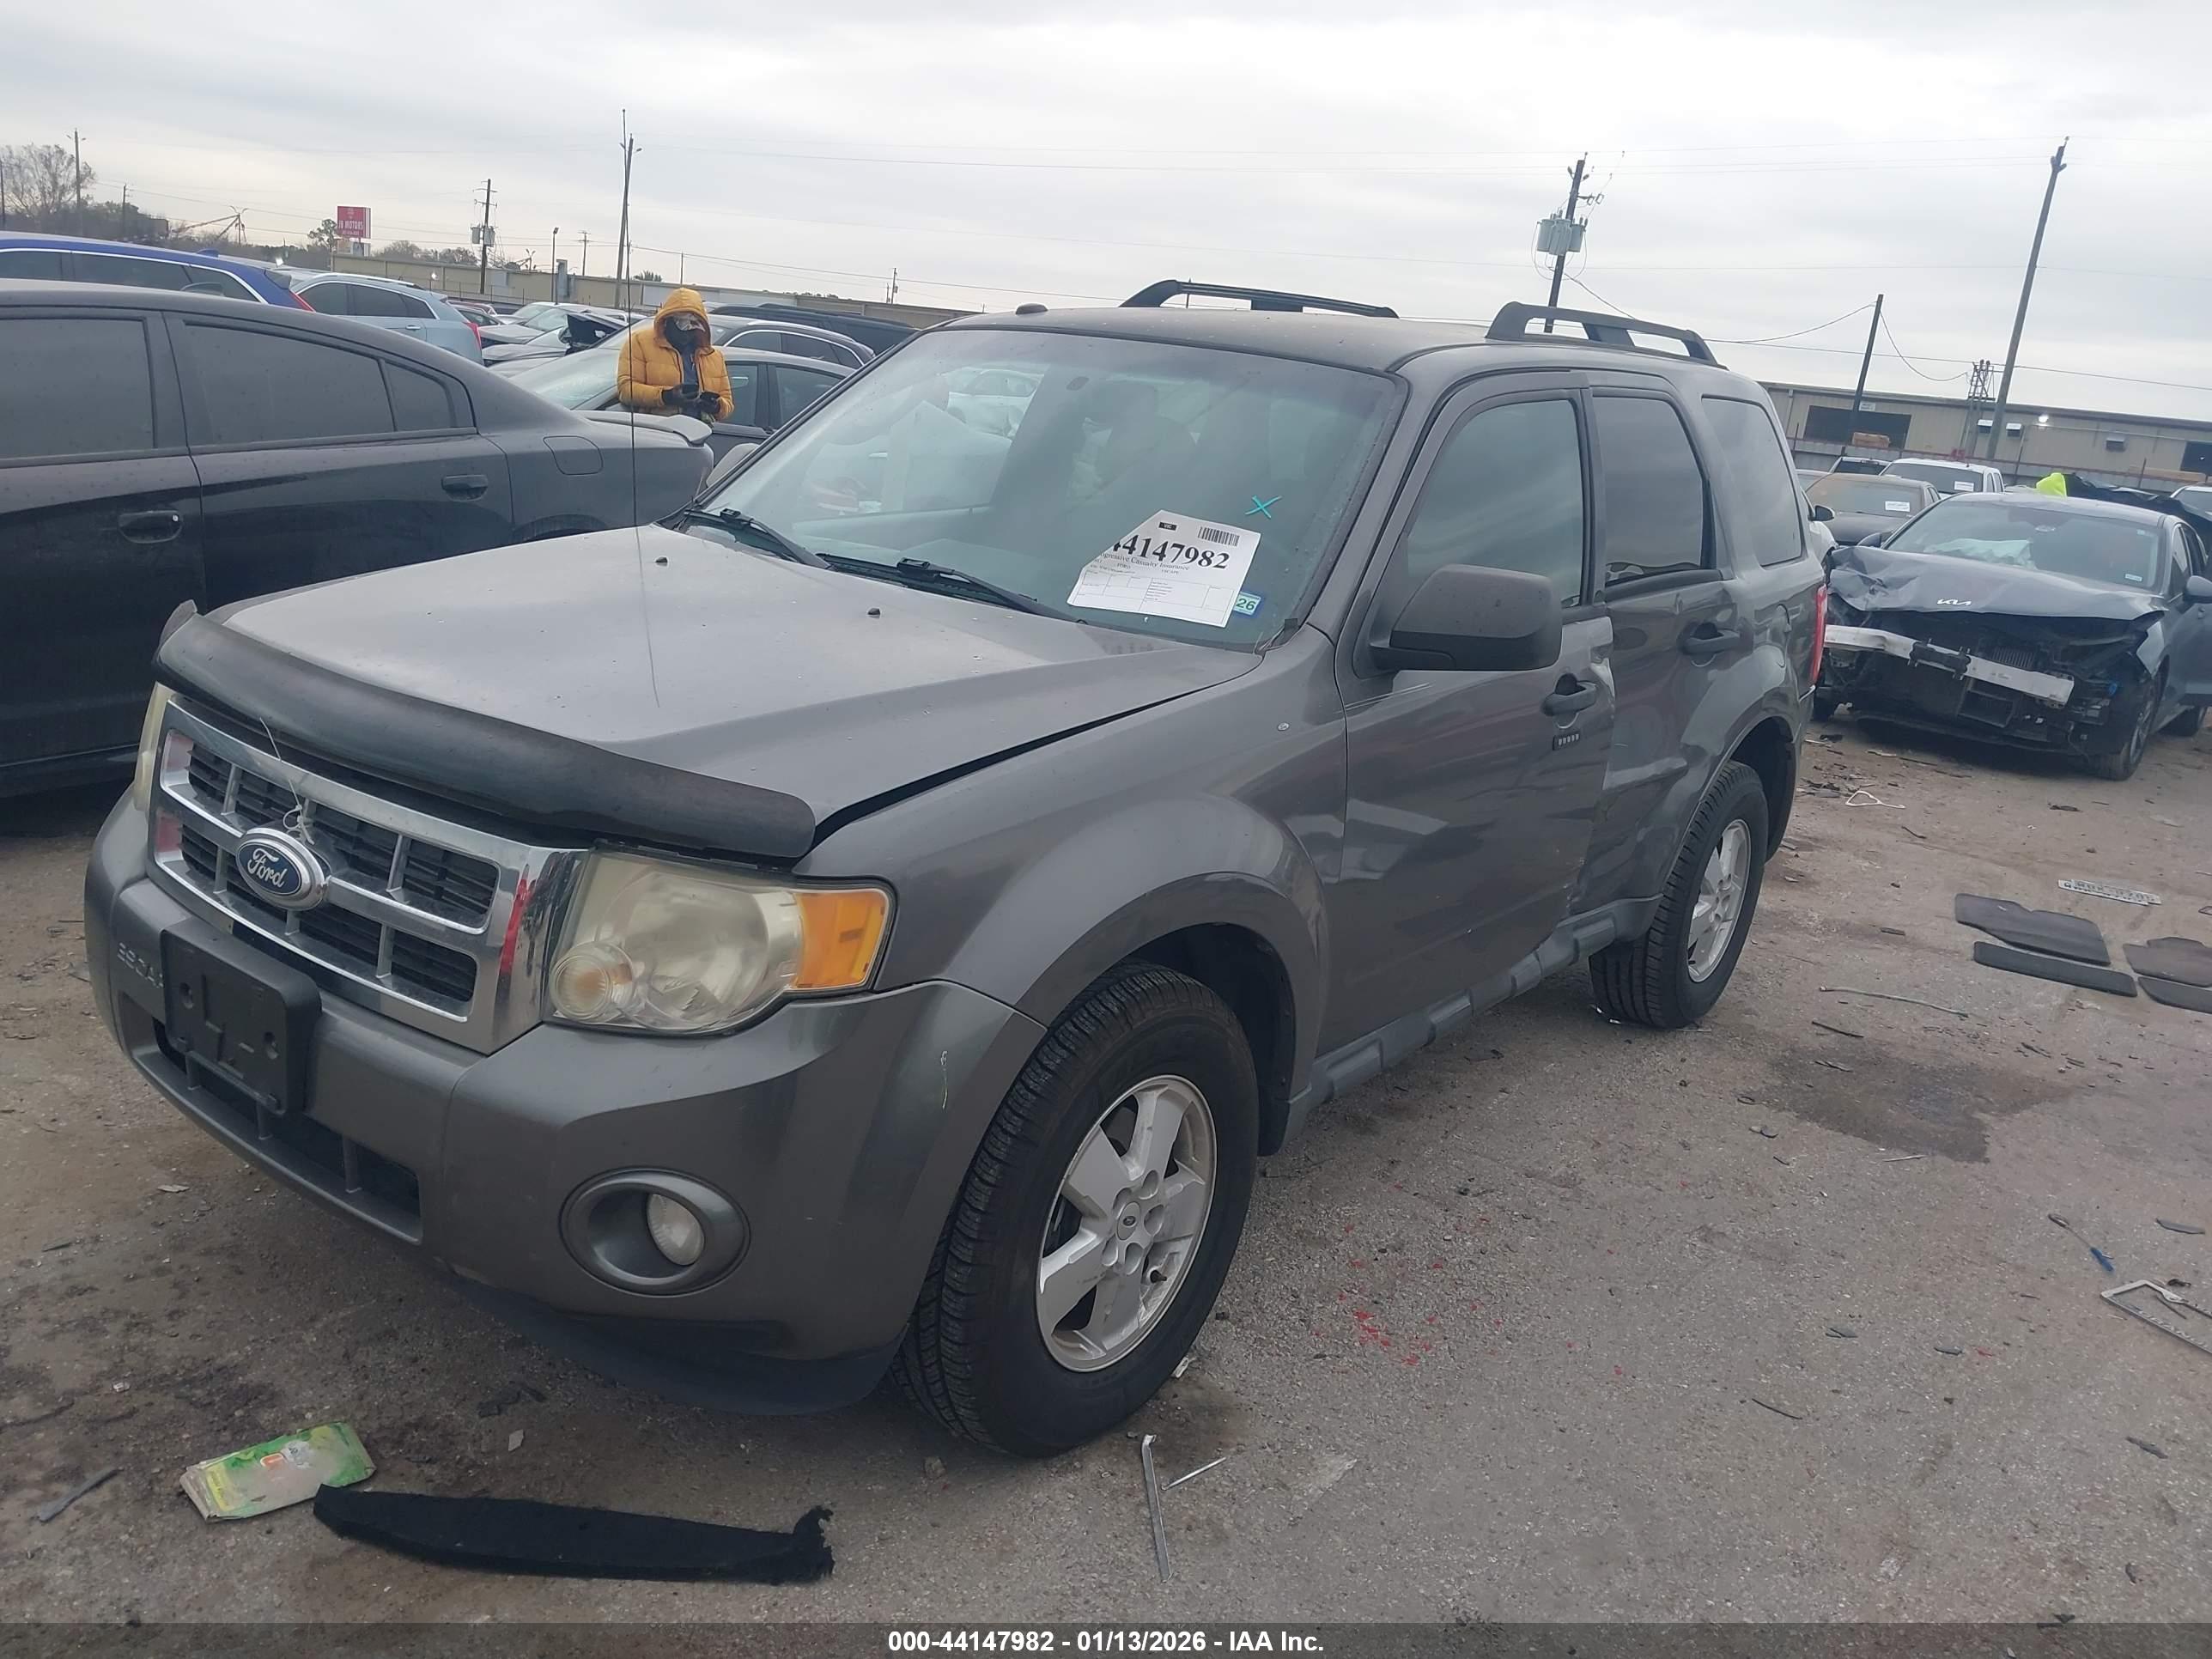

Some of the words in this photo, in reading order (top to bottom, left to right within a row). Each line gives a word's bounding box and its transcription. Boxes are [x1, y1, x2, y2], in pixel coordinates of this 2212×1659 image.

[344, 220, 363, 230] MOTORS
[1131, 556, 1158, 568] Casualty
[1236, 598, 1256, 611] 26
[247, 848, 288, 888] Ford
